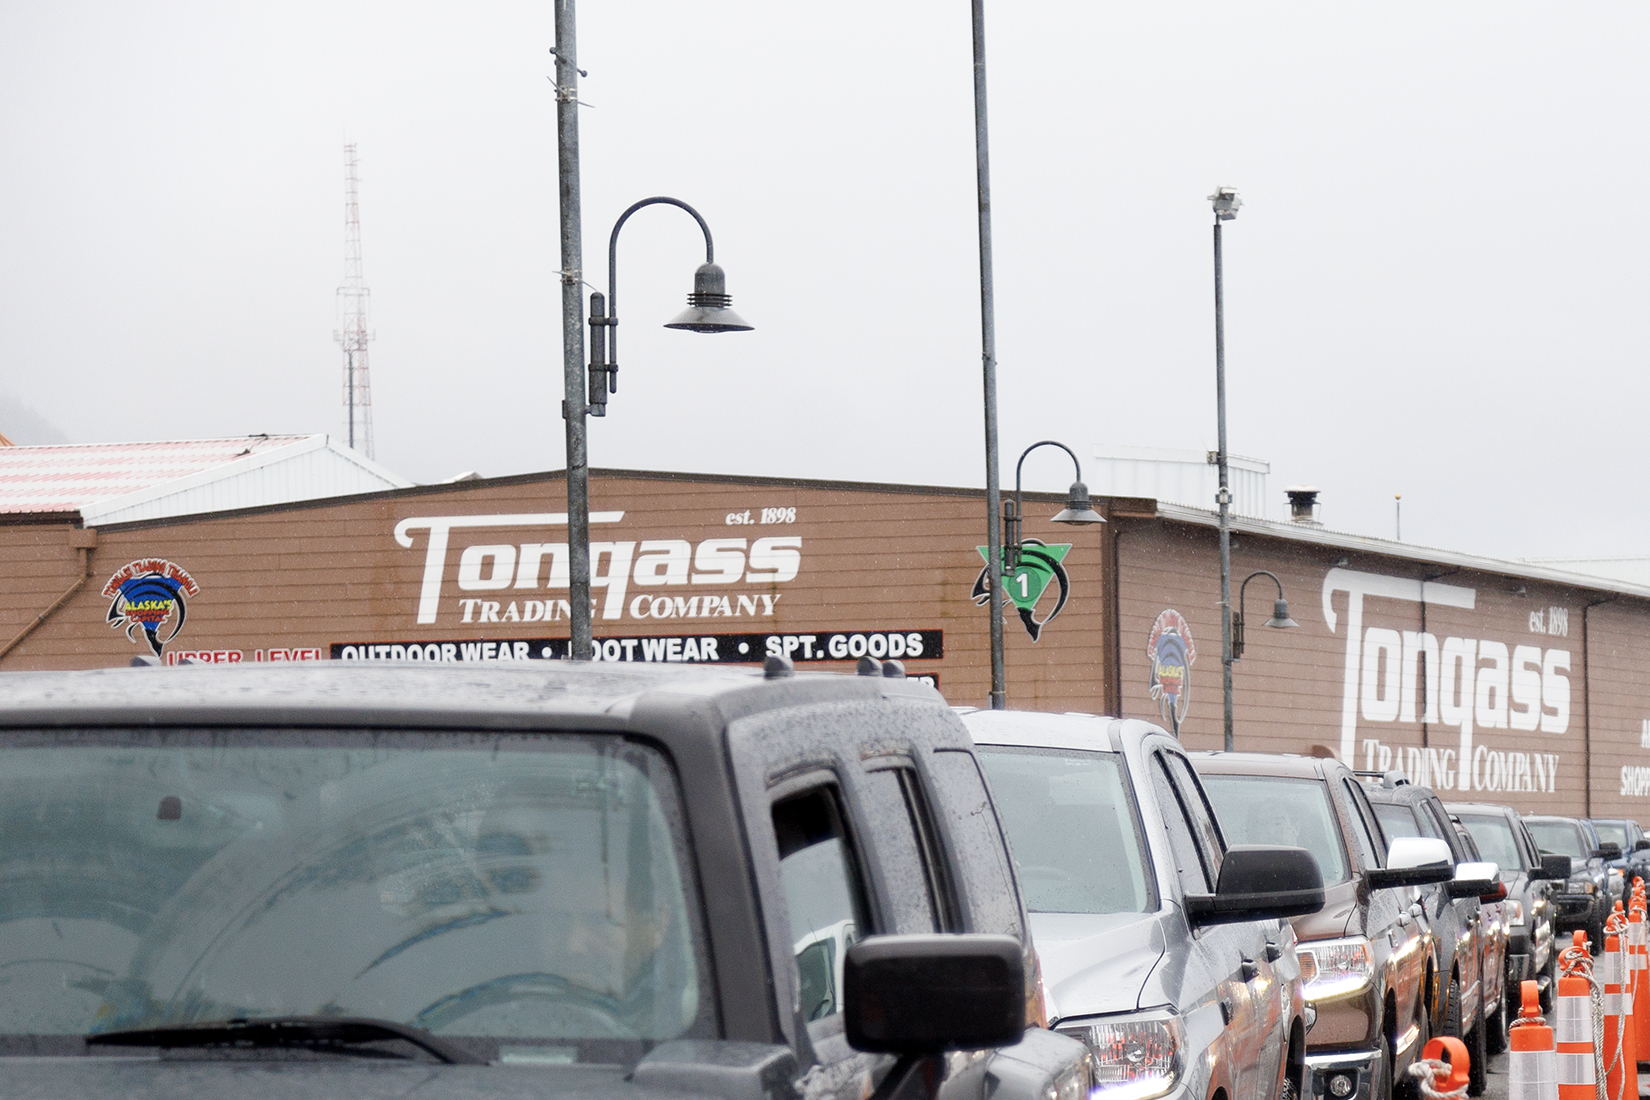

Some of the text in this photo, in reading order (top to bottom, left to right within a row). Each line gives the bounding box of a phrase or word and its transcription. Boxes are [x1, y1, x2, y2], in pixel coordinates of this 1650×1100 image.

[725, 507, 797, 526] est. 1898
[1016, 572, 1028, 598] 1
[125, 599, 172, 611] ALASKA'S
[629, 593, 782, 620] COMPANY
[766, 636, 824, 659] SPT.
[829, 633, 924, 658] GOODS
[1322, 568, 1571, 791] Tongass
[1363, 739, 1559, 793] TRADING COMPANY
